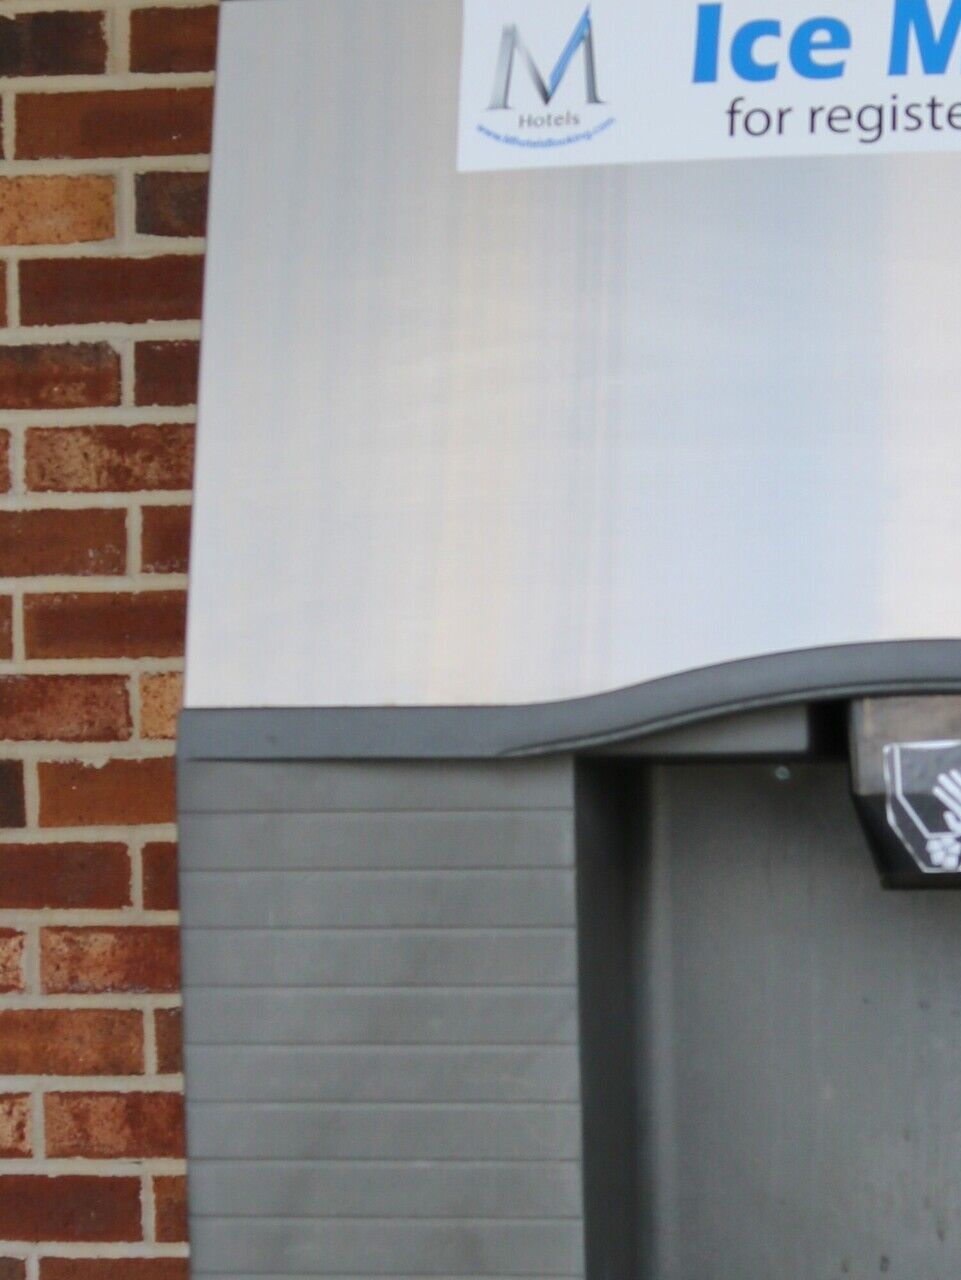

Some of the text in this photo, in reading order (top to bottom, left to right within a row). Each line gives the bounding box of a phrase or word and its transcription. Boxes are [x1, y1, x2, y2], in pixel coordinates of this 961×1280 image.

[486, 2, 605, 110] M
[691, 2, 853, 85] Ice
[518, 110, 581, 128] Hotels
[726, 97, 793, 137] for
